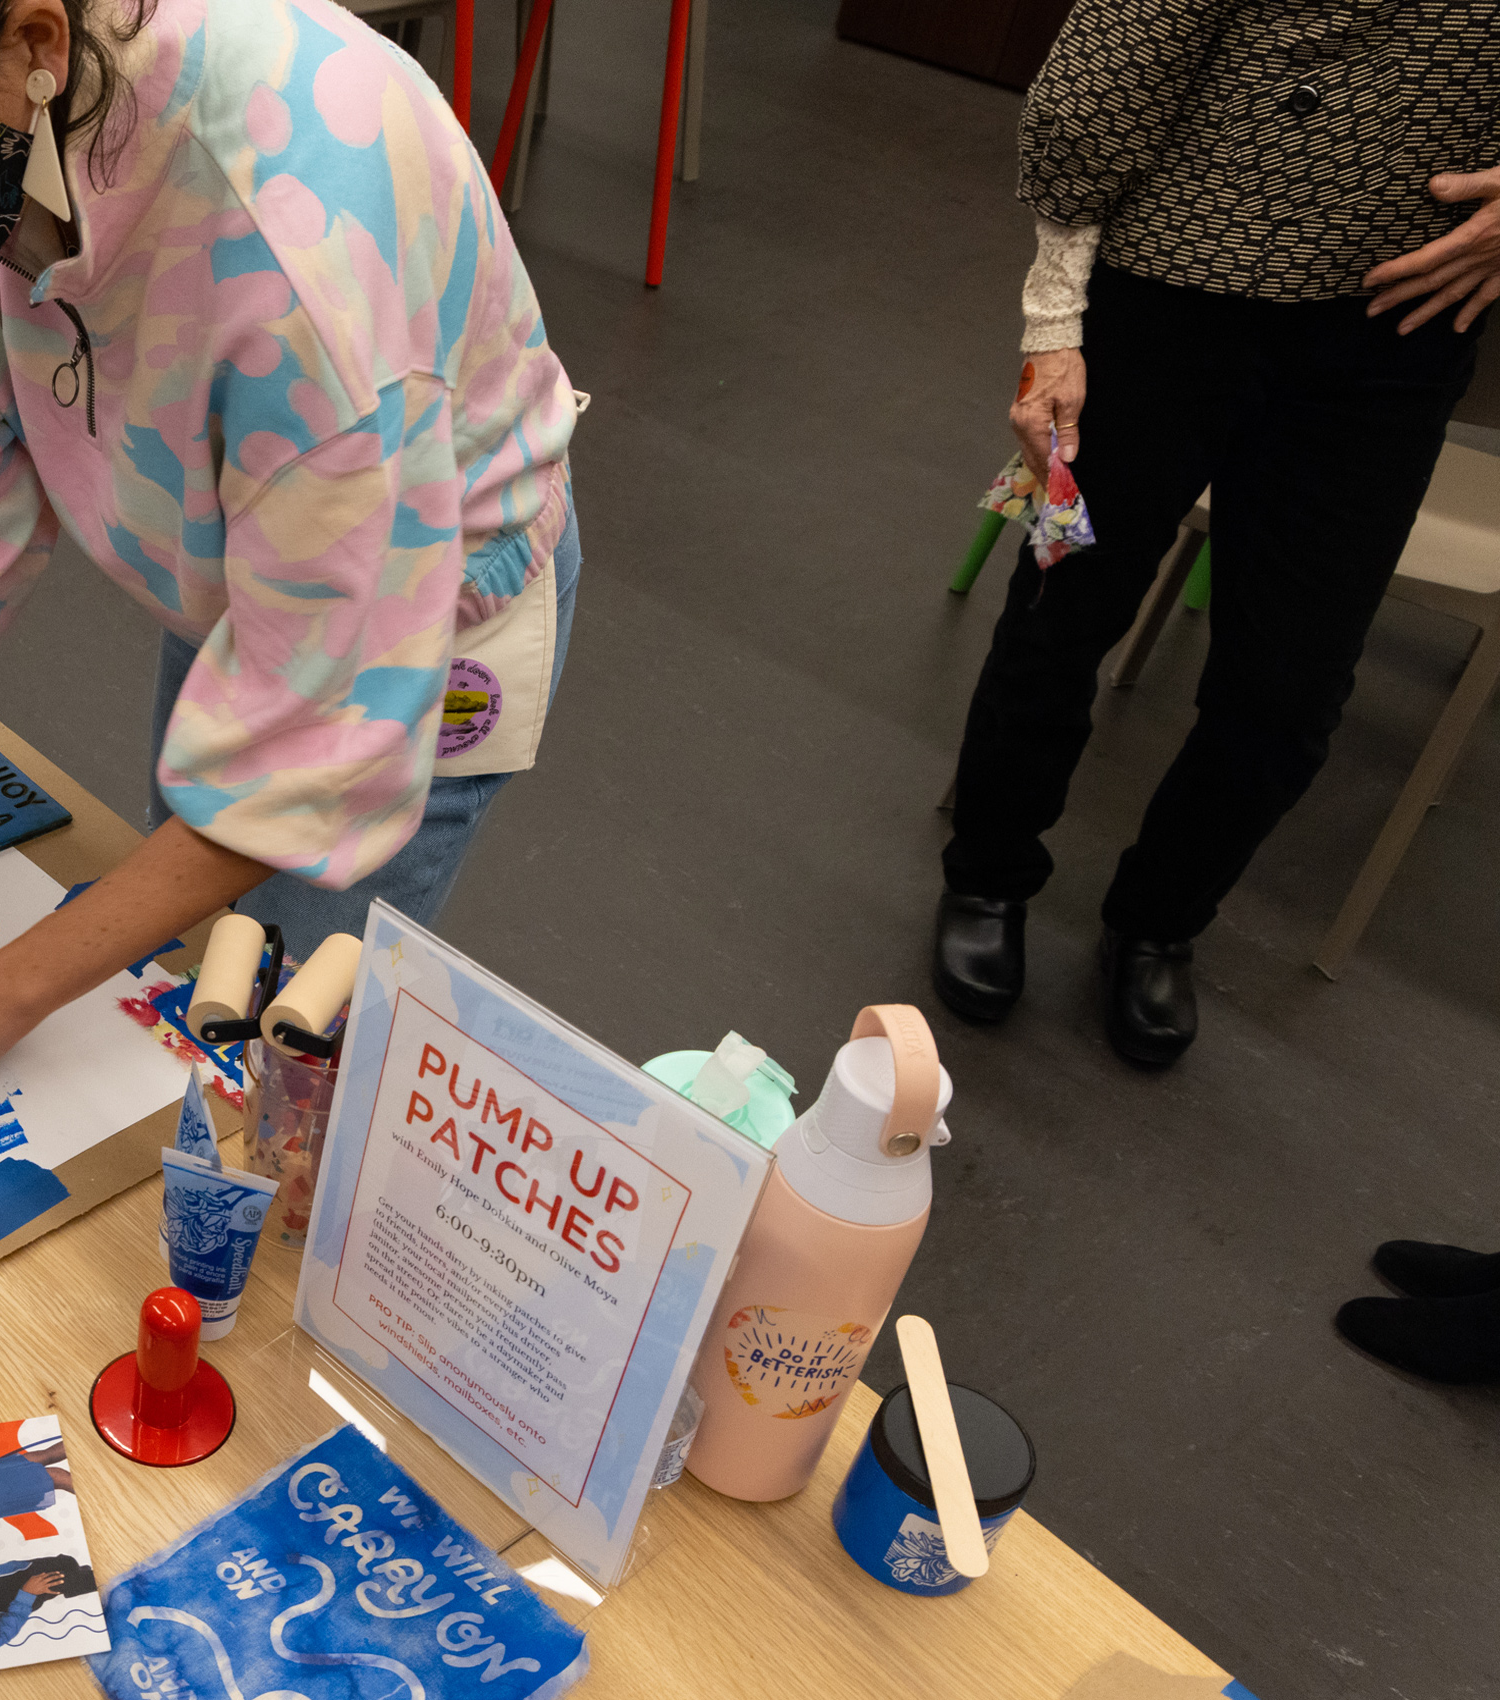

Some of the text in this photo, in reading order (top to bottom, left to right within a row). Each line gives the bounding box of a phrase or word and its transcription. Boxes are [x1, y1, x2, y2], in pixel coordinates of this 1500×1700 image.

[479, 719, 491, 735] all
[489, 693, 501, 716] look
[406, 1090, 625, 1274] PATCHES
[418, 1042, 553, 1154] PUMP
[569, 1149, 639, 1213] UP
[229, 1237, 252, 1291] Speedball
[375, 1208, 561, 1358] to friends, lovers, and/or everyday heroes
[378, 1196, 587, 1363] Get your hands dirty by inking patches to give
[391, 1131, 619, 1307] with Emily Hope Dobkin and Olive Moya
[435, 1204, 547, 1298] 6:00-9:30pm
[363, 1262, 437, 1325] needs it the most.
[366, 1252, 394, 1278] spread
[395, 1274, 410, 1290] the
[410, 1288, 445, 1318] positive
[446, 1317, 469, 1340] vibes
[470, 1336, 481, 1348] to
[488, 1352, 528, 1386] stranger
[529, 1383, 550, 1403] who
[368, 1241, 380, 1254] on
[381, 1251, 395, 1265] the
[443, 1301, 464, 1321] dare
[465, 1318, 476, 1331] to
[476, 1328, 488, 1340] be
[496, 1342, 544, 1384] daymaker
[545, 1382, 565, 1402] and
[369, 1229, 567, 1391] janitor, awesome person you frequently pass
[402, 1242, 423, 1261] your
[424, 1258, 446, 1280] local
[446, 1278, 500, 1325] mailperson,
[501, 1320, 519, 1339] bus
[520, 1334, 552, 1366] driver,
[368, 1293, 547, 1445] PRO TIP: Slip anonymously onto
[378, 1319, 527, 1448] windshields, mailboxes, etc.
[750, 1348, 844, 1379] BETTERISH
[215, 1561, 264, 1601] ON
[231, 1546, 287, 1594] AND
[288, 1462, 542, 1684] CARRY ON
[431, 1534, 512, 1606] WILL
